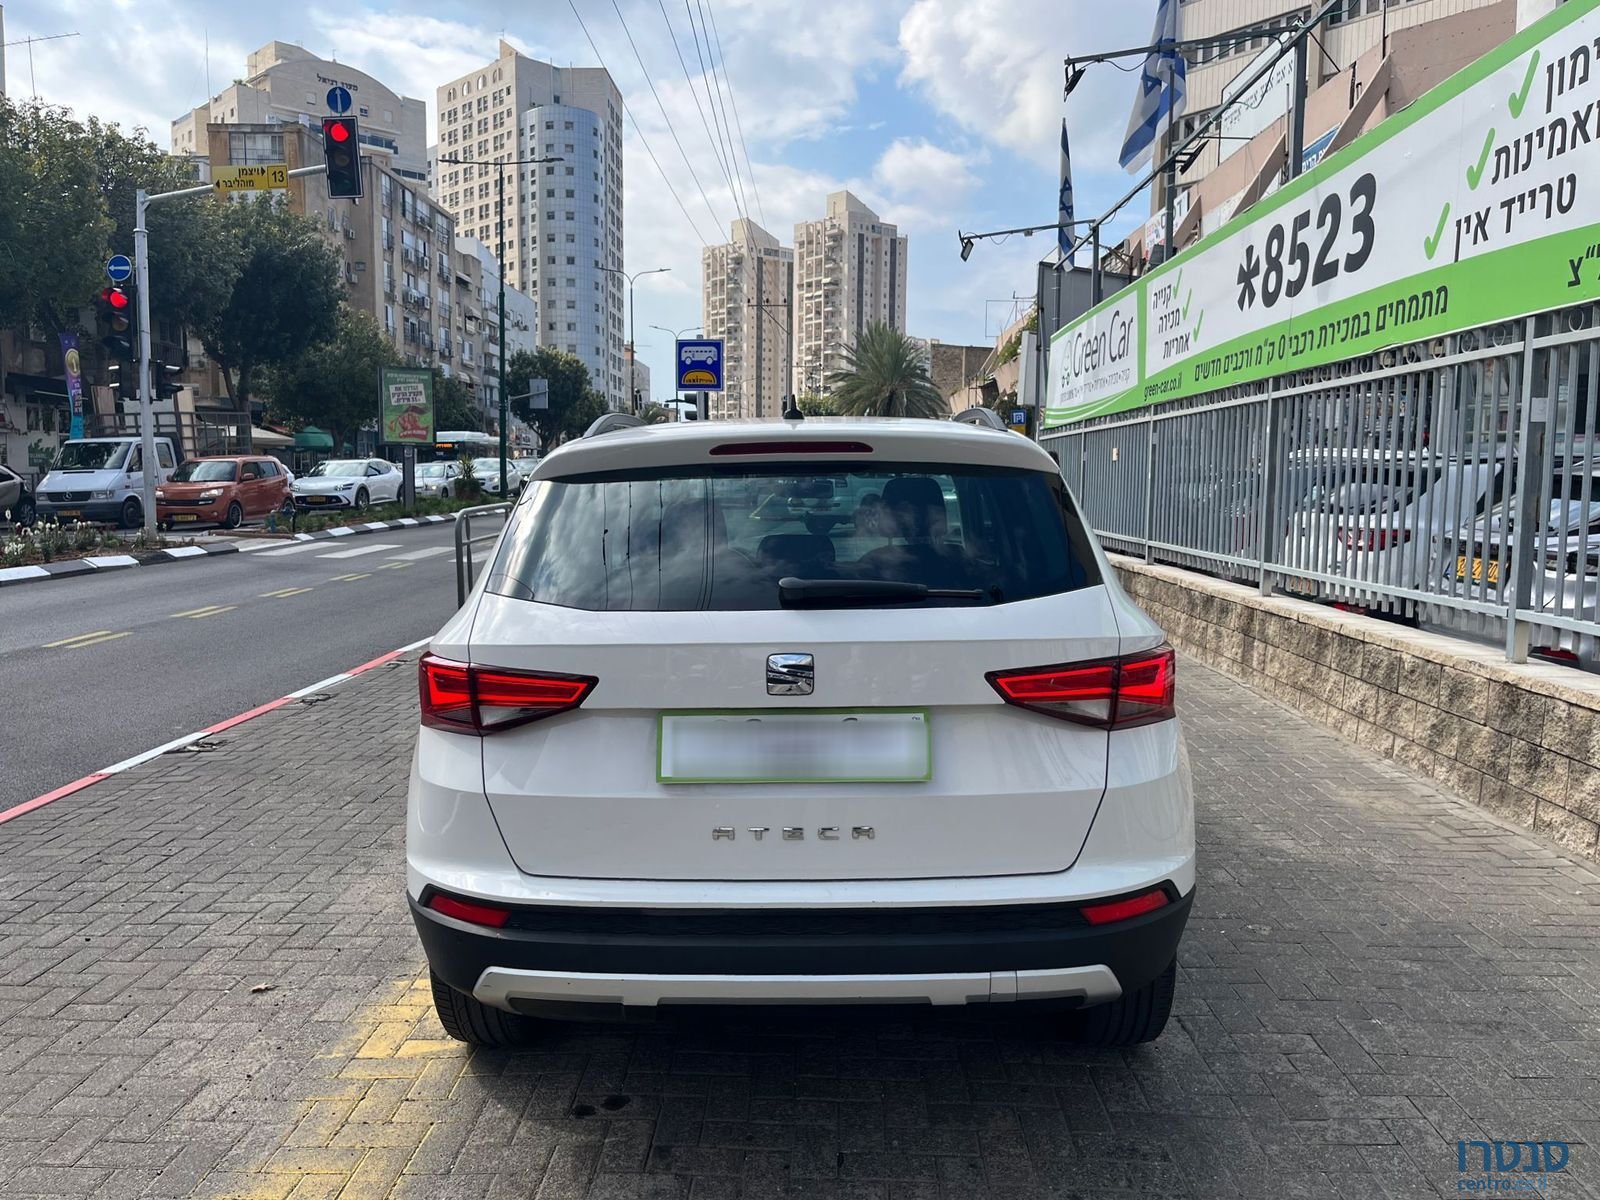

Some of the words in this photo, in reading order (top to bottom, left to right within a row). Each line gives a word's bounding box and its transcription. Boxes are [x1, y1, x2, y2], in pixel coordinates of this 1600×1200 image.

[222, 176, 255, 188] מוהליבר
[238, 167, 260, 179] ויצמן
[271, 170, 285, 183] 13
[1500, 173, 1577, 234] טרייד
[1453, 206, 1492, 263] אין
[1152, 284, 1172, 310] קנייה
[1375, 285, 1449, 332] מתמחים
[1158, 308, 1181, 333] מכירה
[1316, 311, 1371, 349] במכירת
[1073, 331, 1107, 378] Green
[1108, 310, 1134, 362] Car
[1163, 332, 1191, 359] אחריות
[1278, 334, 1286, 360] 0
[1289, 328, 1315, 357] רכבי
[1194, 357, 1222, 382] חדשים
[1223, 347, 1254, 374] ורכבים
[1143, 372, 1182, 401] green-car.co.il
[711, 826, 876, 841] ATECA
